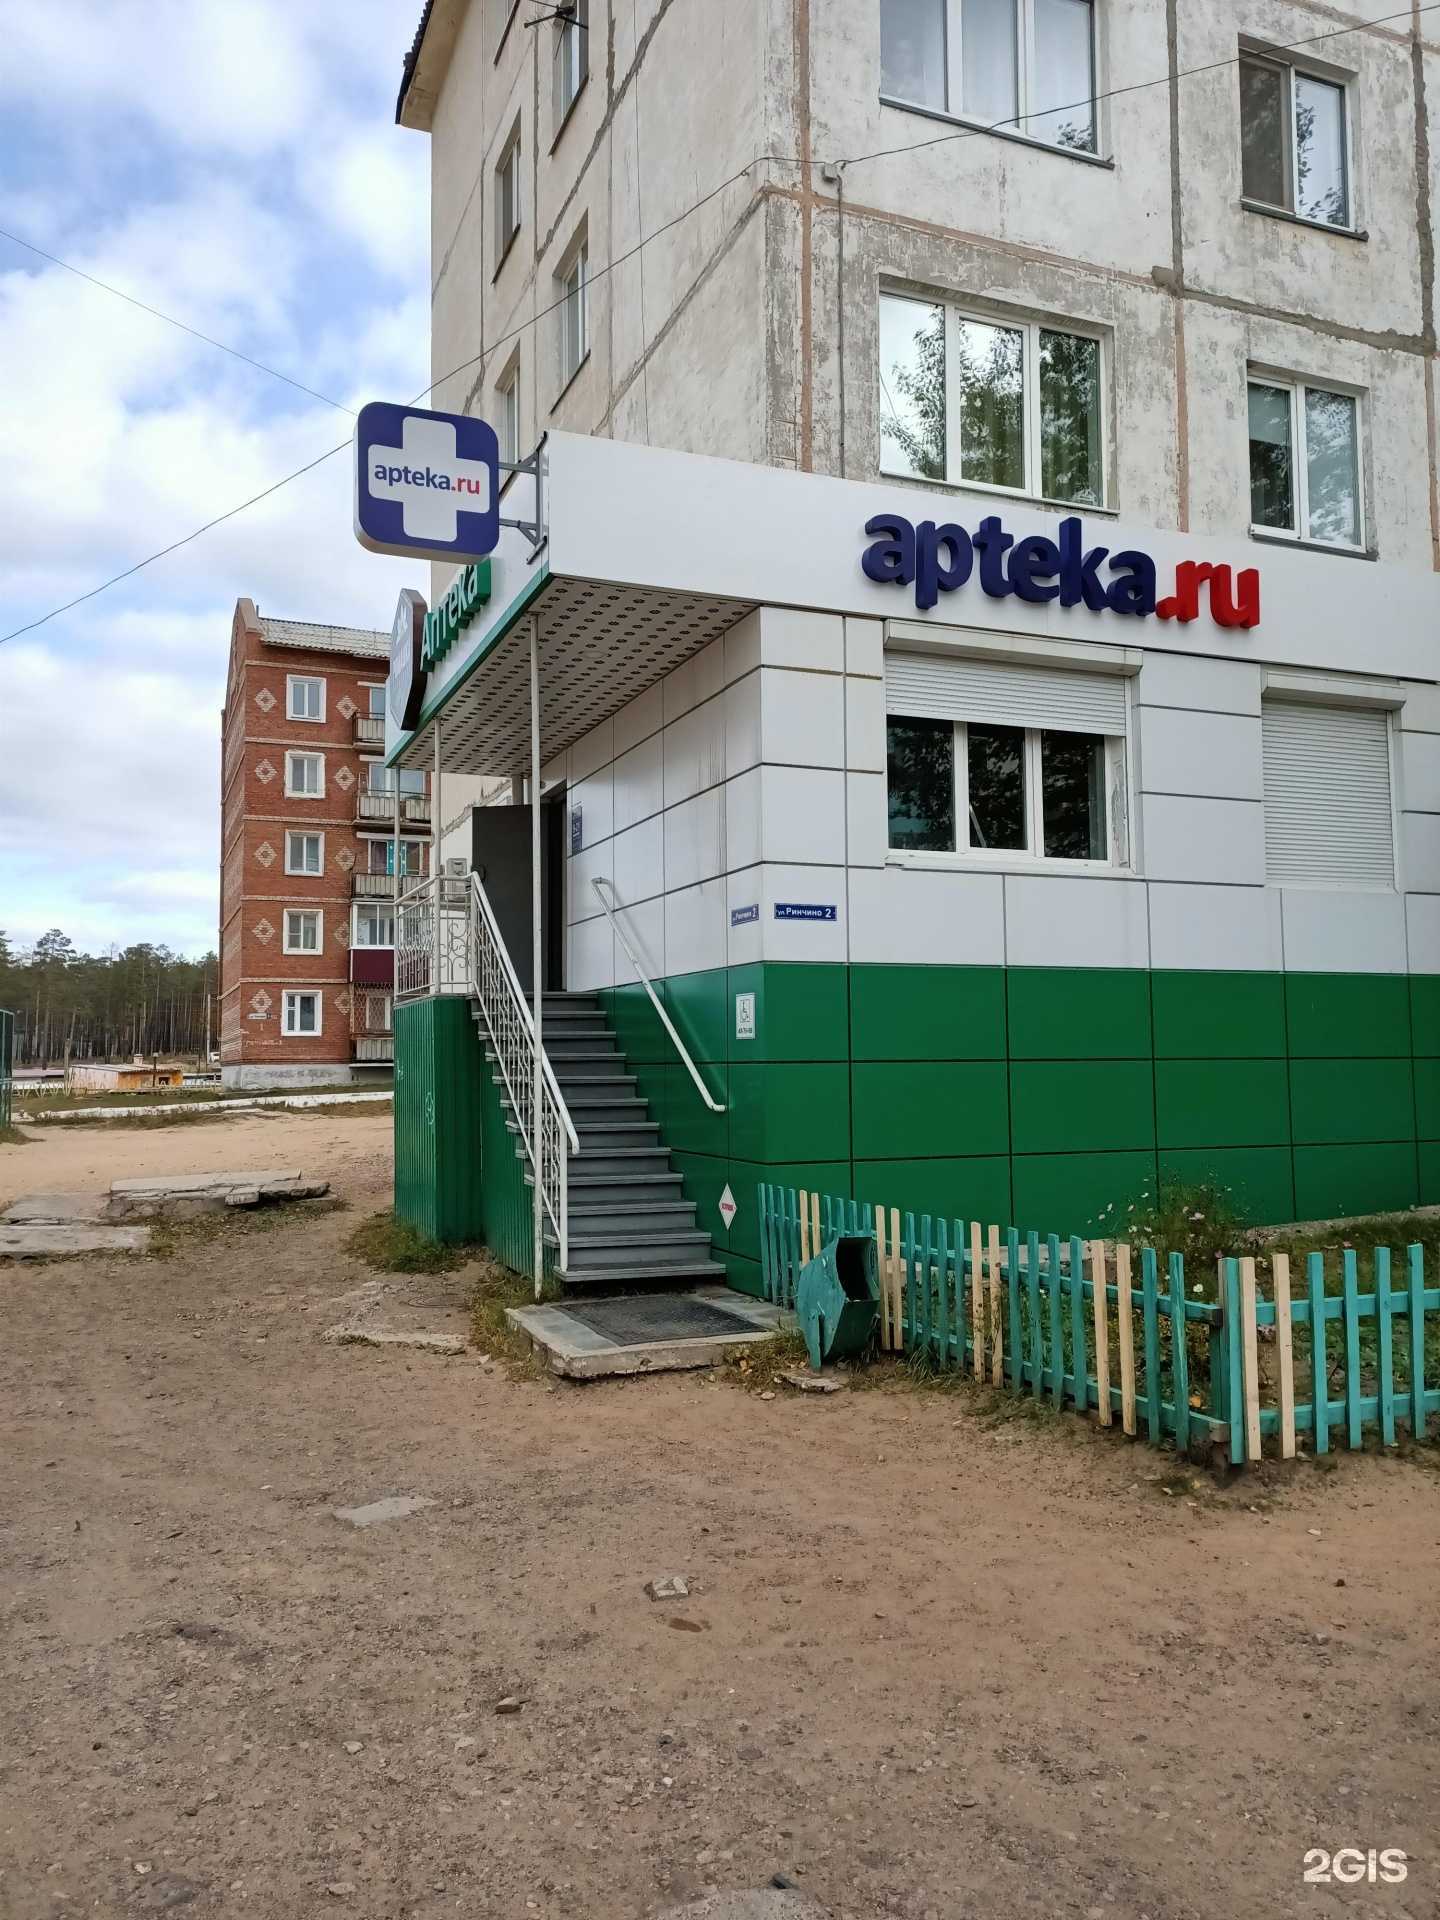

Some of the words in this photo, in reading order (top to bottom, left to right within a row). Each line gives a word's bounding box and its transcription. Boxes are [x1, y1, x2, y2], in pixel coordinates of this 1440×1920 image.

[374, 464, 480, 494] apteka.ru
[861, 513, 1261, 630] apteka.ru
[786, 906, 823, 917] Ринчино
[825, 908, 832, 918] 2
